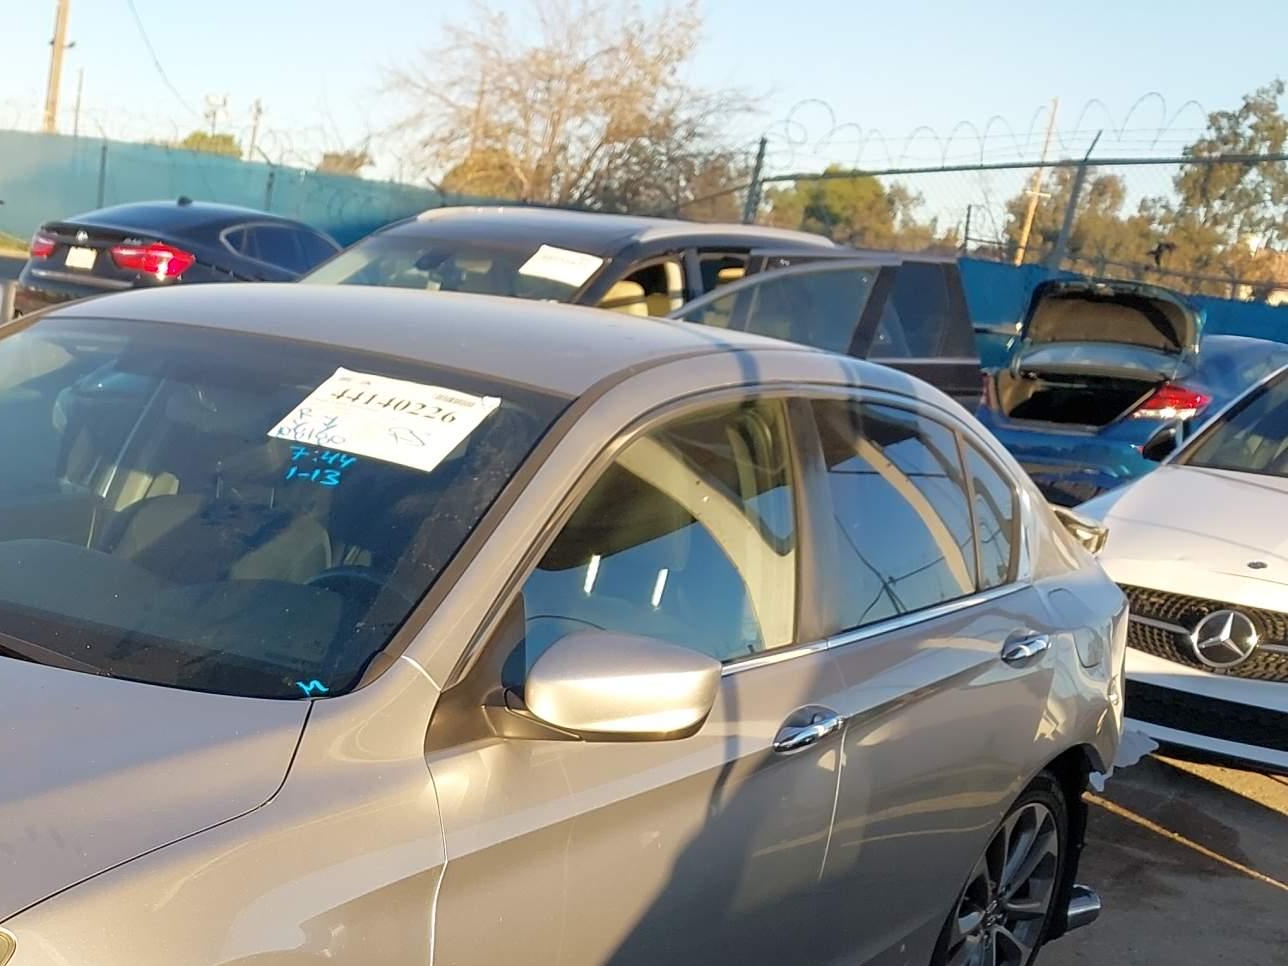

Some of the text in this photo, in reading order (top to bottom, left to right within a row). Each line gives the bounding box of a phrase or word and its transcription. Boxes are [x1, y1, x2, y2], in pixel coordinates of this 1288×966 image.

[331, 388, 456, 423] 44140226
[290, 446, 357, 468] 7:44
[285, 465, 341, 486] 1-13
